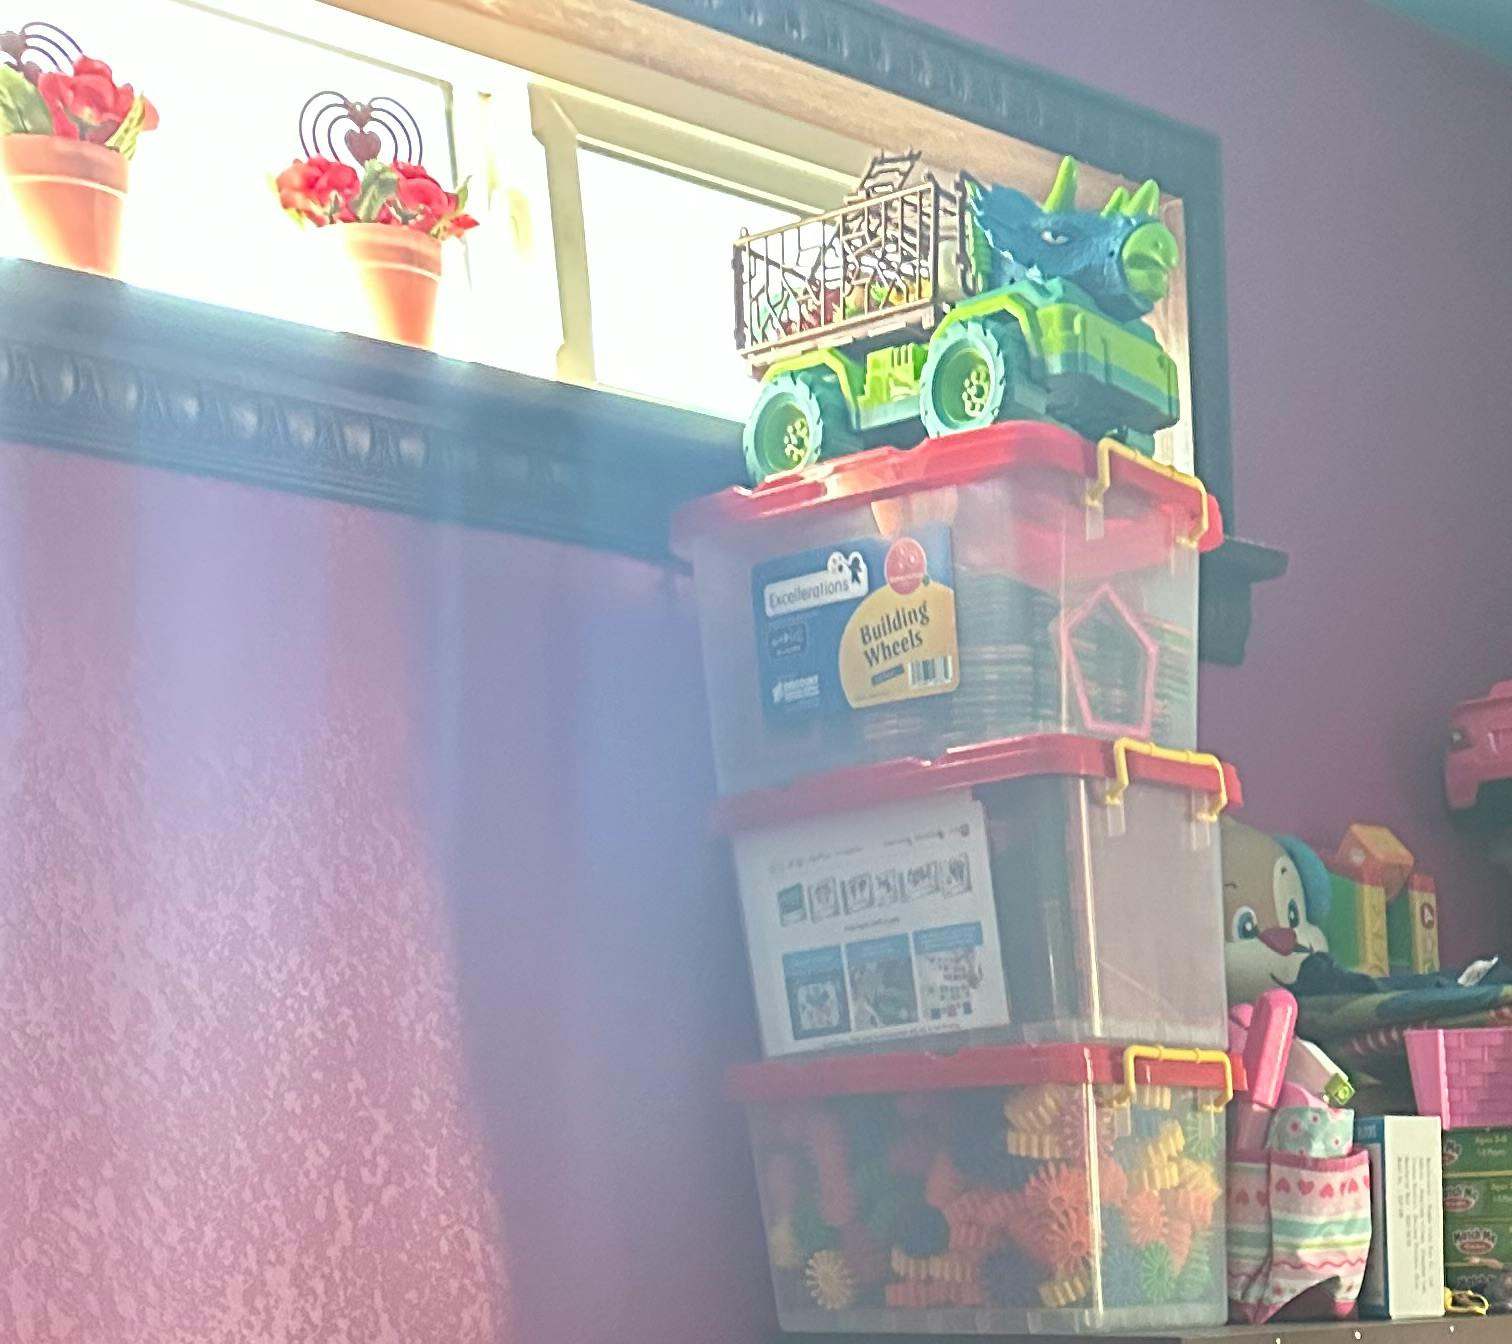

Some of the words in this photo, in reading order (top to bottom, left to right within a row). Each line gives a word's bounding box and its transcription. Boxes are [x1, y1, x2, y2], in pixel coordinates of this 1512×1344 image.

[768, 579, 850, 610] Excellerations
[859, 600, 930, 646] Building
[864, 629, 924, 668] Wheels
